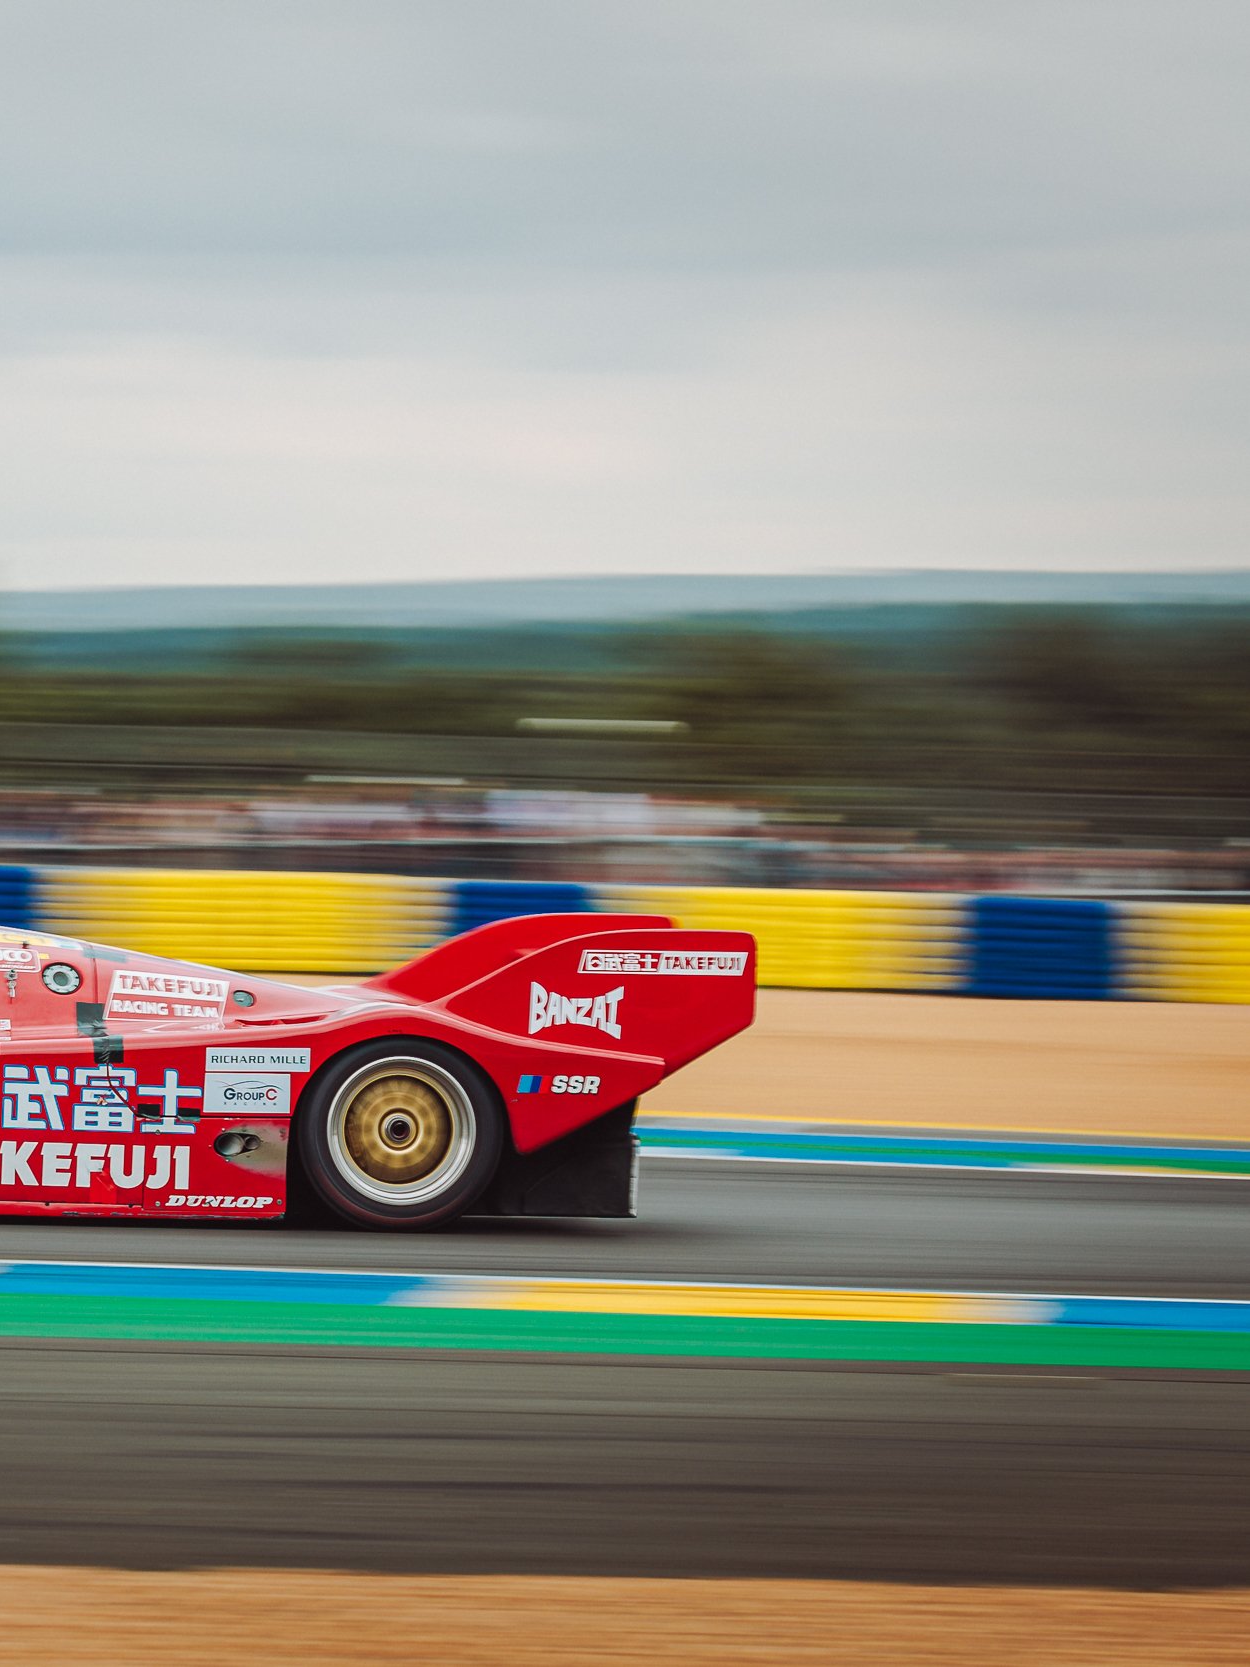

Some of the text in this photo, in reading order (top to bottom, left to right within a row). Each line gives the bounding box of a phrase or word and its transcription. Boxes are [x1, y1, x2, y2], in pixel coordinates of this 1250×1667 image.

[604, 953, 658, 972] 武富士
[664, 956, 741, 971] TAKEFUJI
[119, 974, 224, 998] TAKEFUJI
[111, 999, 219, 1018] RACING TEAM
[528, 981, 625, 1040] BANZAI
[211, 1055, 307, 1065] RICHARD MILLE
[551, 1075, 600, 1095] SSR
[2, 1063, 203, 1135] 武富士
[166, 1194, 274, 1209] DUNLOP
